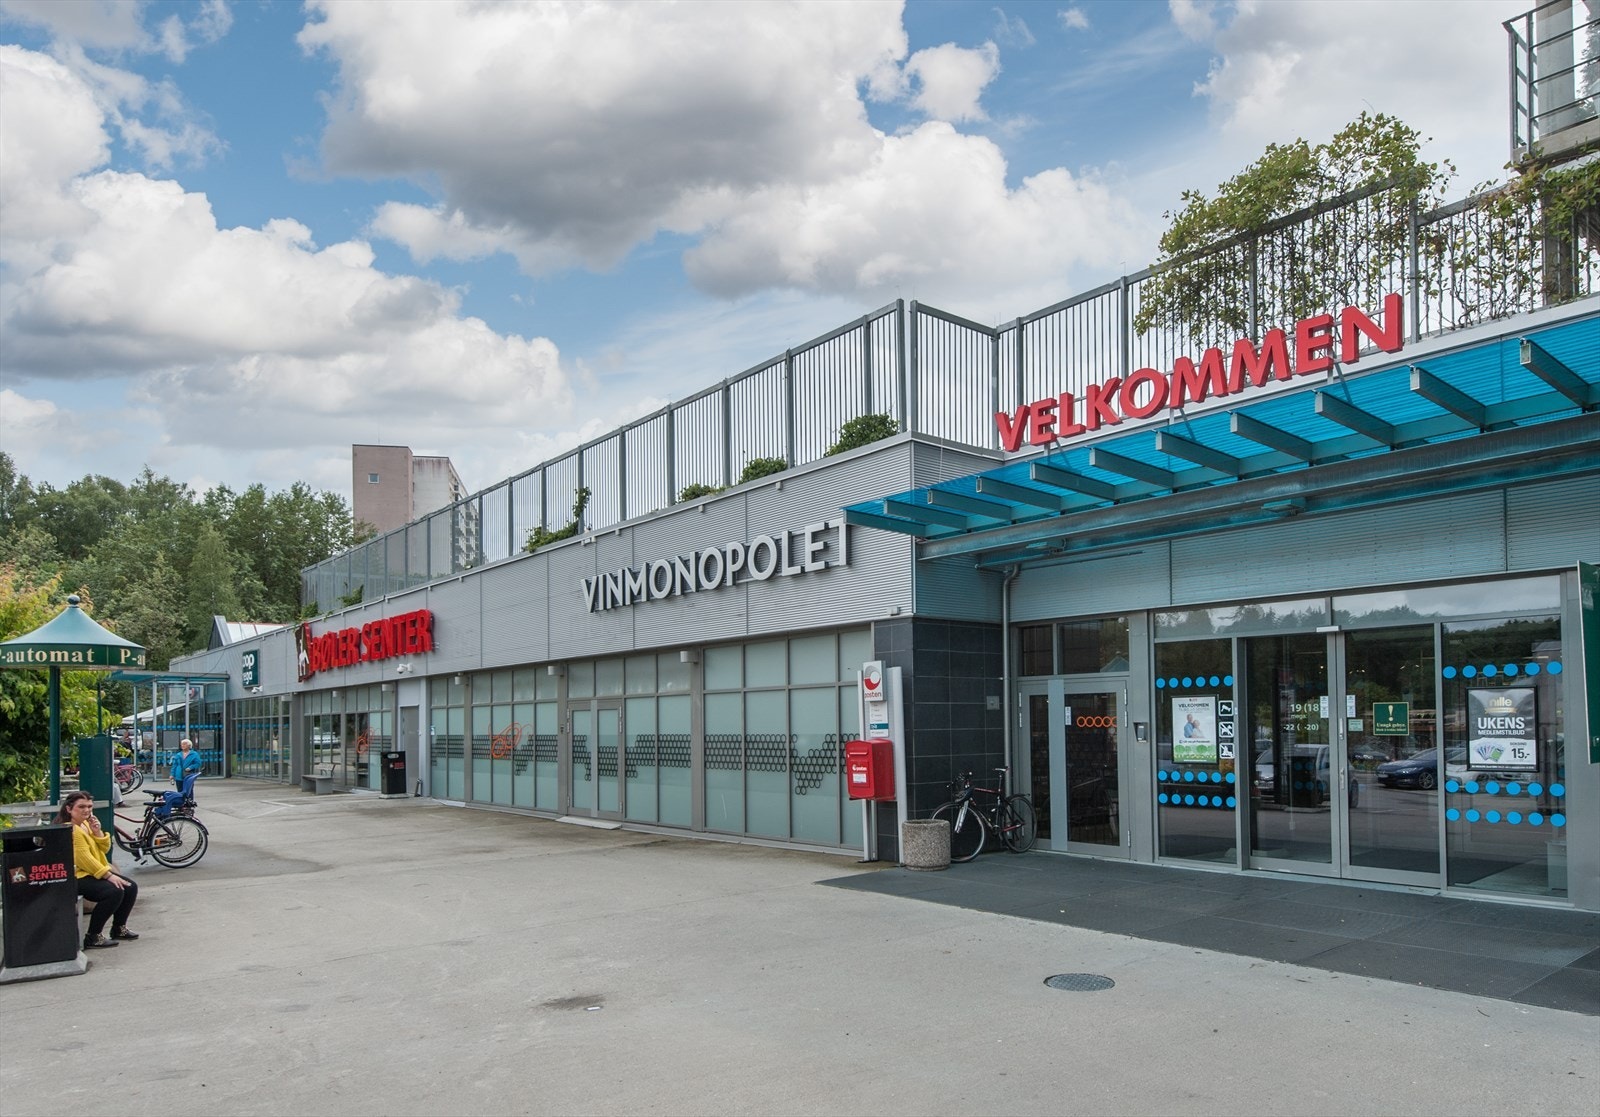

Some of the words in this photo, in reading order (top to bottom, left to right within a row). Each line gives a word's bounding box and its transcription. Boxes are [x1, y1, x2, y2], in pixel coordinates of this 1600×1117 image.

[995, 293, 1403, 452] VELKOMMEN
[581, 518, 849, 613] VINMONOPOLET
[311, 627, 360, 672] BØLER
[361, 609, 432, 662] SENTER
[0, 647, 95, 663] -automat
[242, 671, 253, 684] ega
[1290, 703, 1302, 712] 19
[1489, 696, 1512, 707] nille
[1478, 717, 1525, 729] UKENS
[1511, 748, 1530, 759] 15,-
[31, 863, 64, 872] BØLER
[29, 870, 67, 880] SENTER
